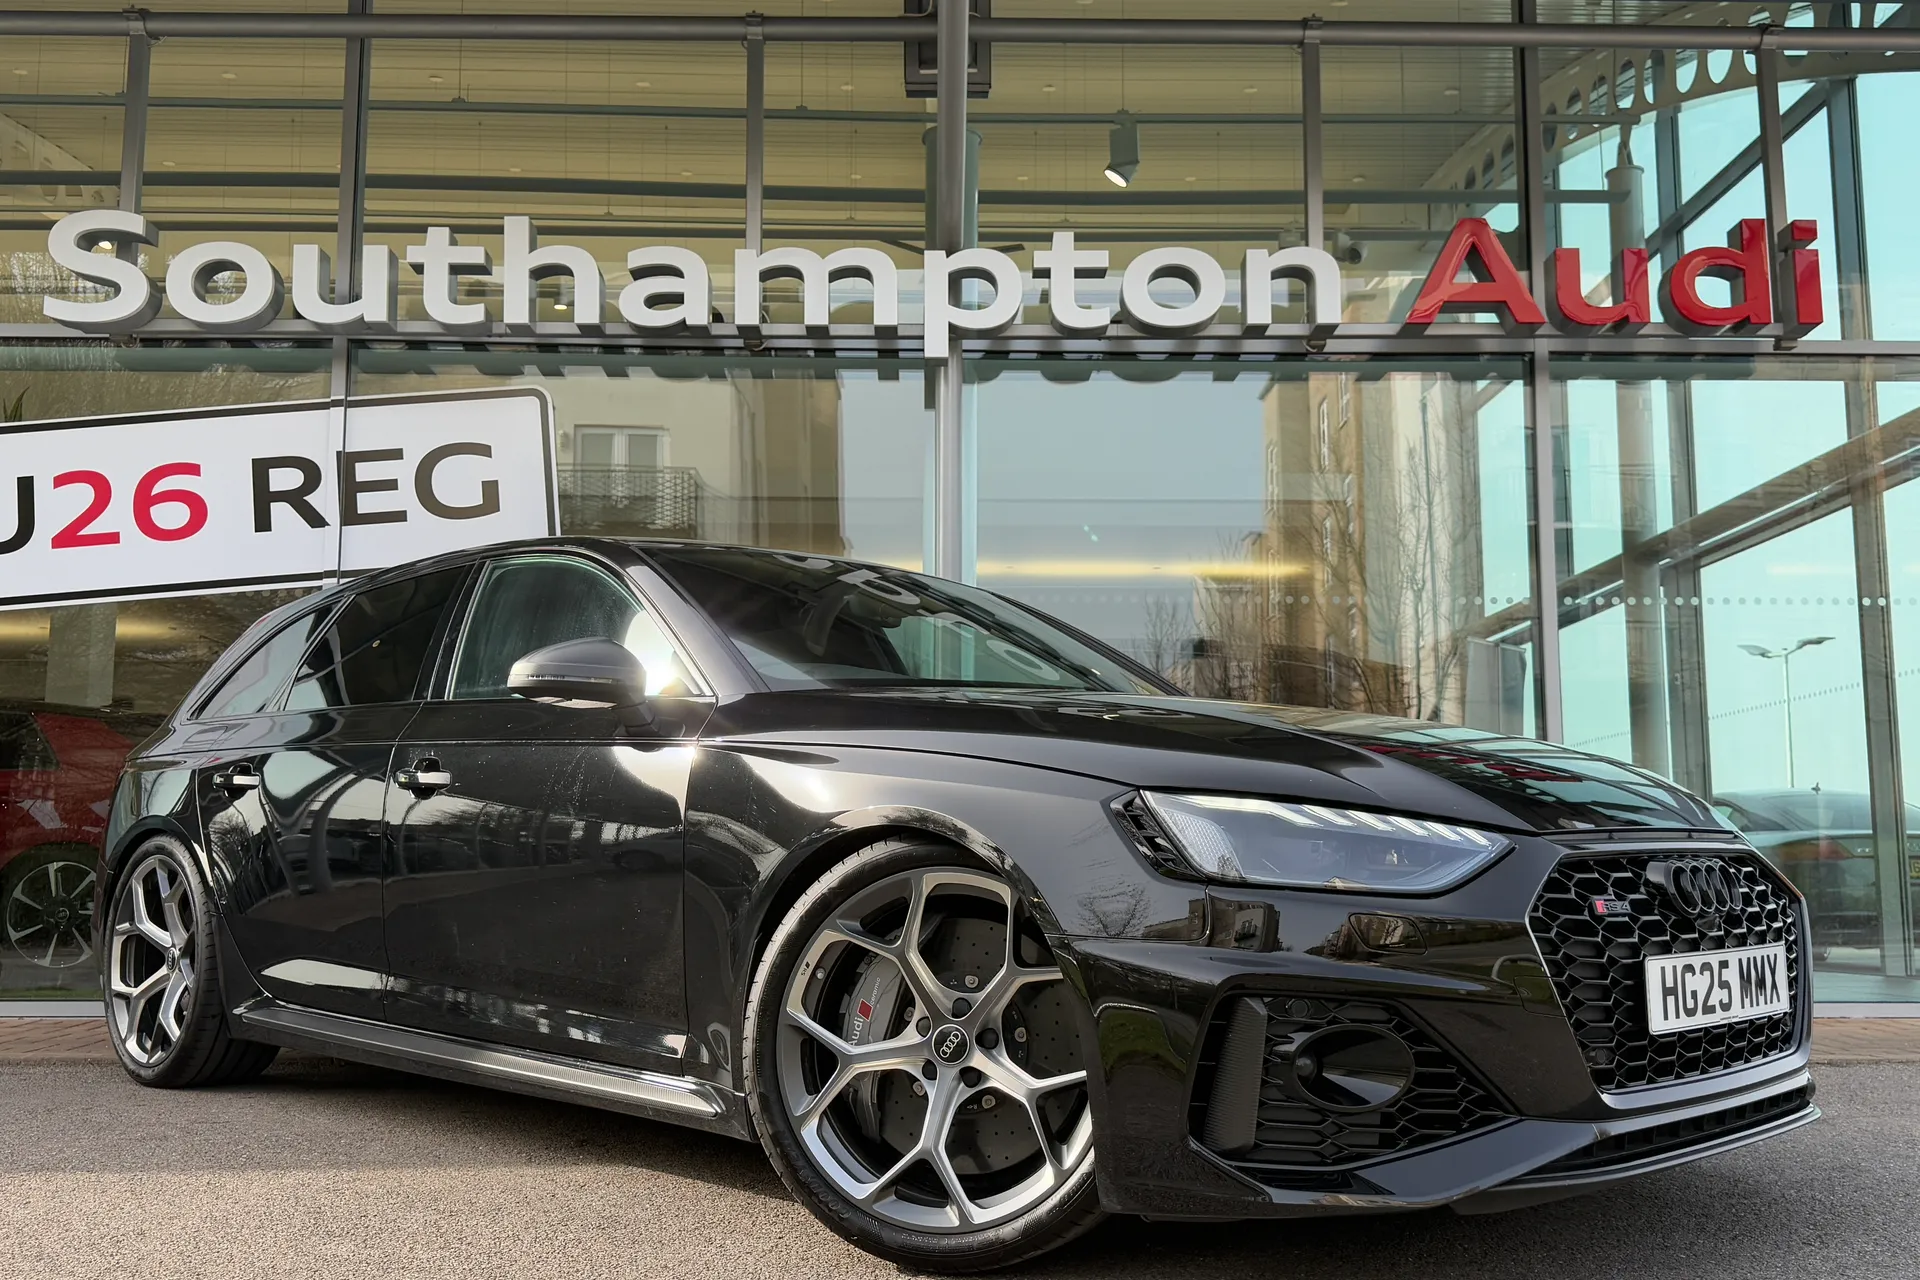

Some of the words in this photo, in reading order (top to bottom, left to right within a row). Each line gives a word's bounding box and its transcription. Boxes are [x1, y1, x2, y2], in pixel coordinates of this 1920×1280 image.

[43, 208, 1343, 365] Southampton
[1400, 217, 1823, 336] Audi
[251, 442, 500, 533] REG
[870, 977, 880, 1005] ceramic
[1660, 959, 1733, 1021] HG25
[1738, 953, 1780, 1009] MMX
